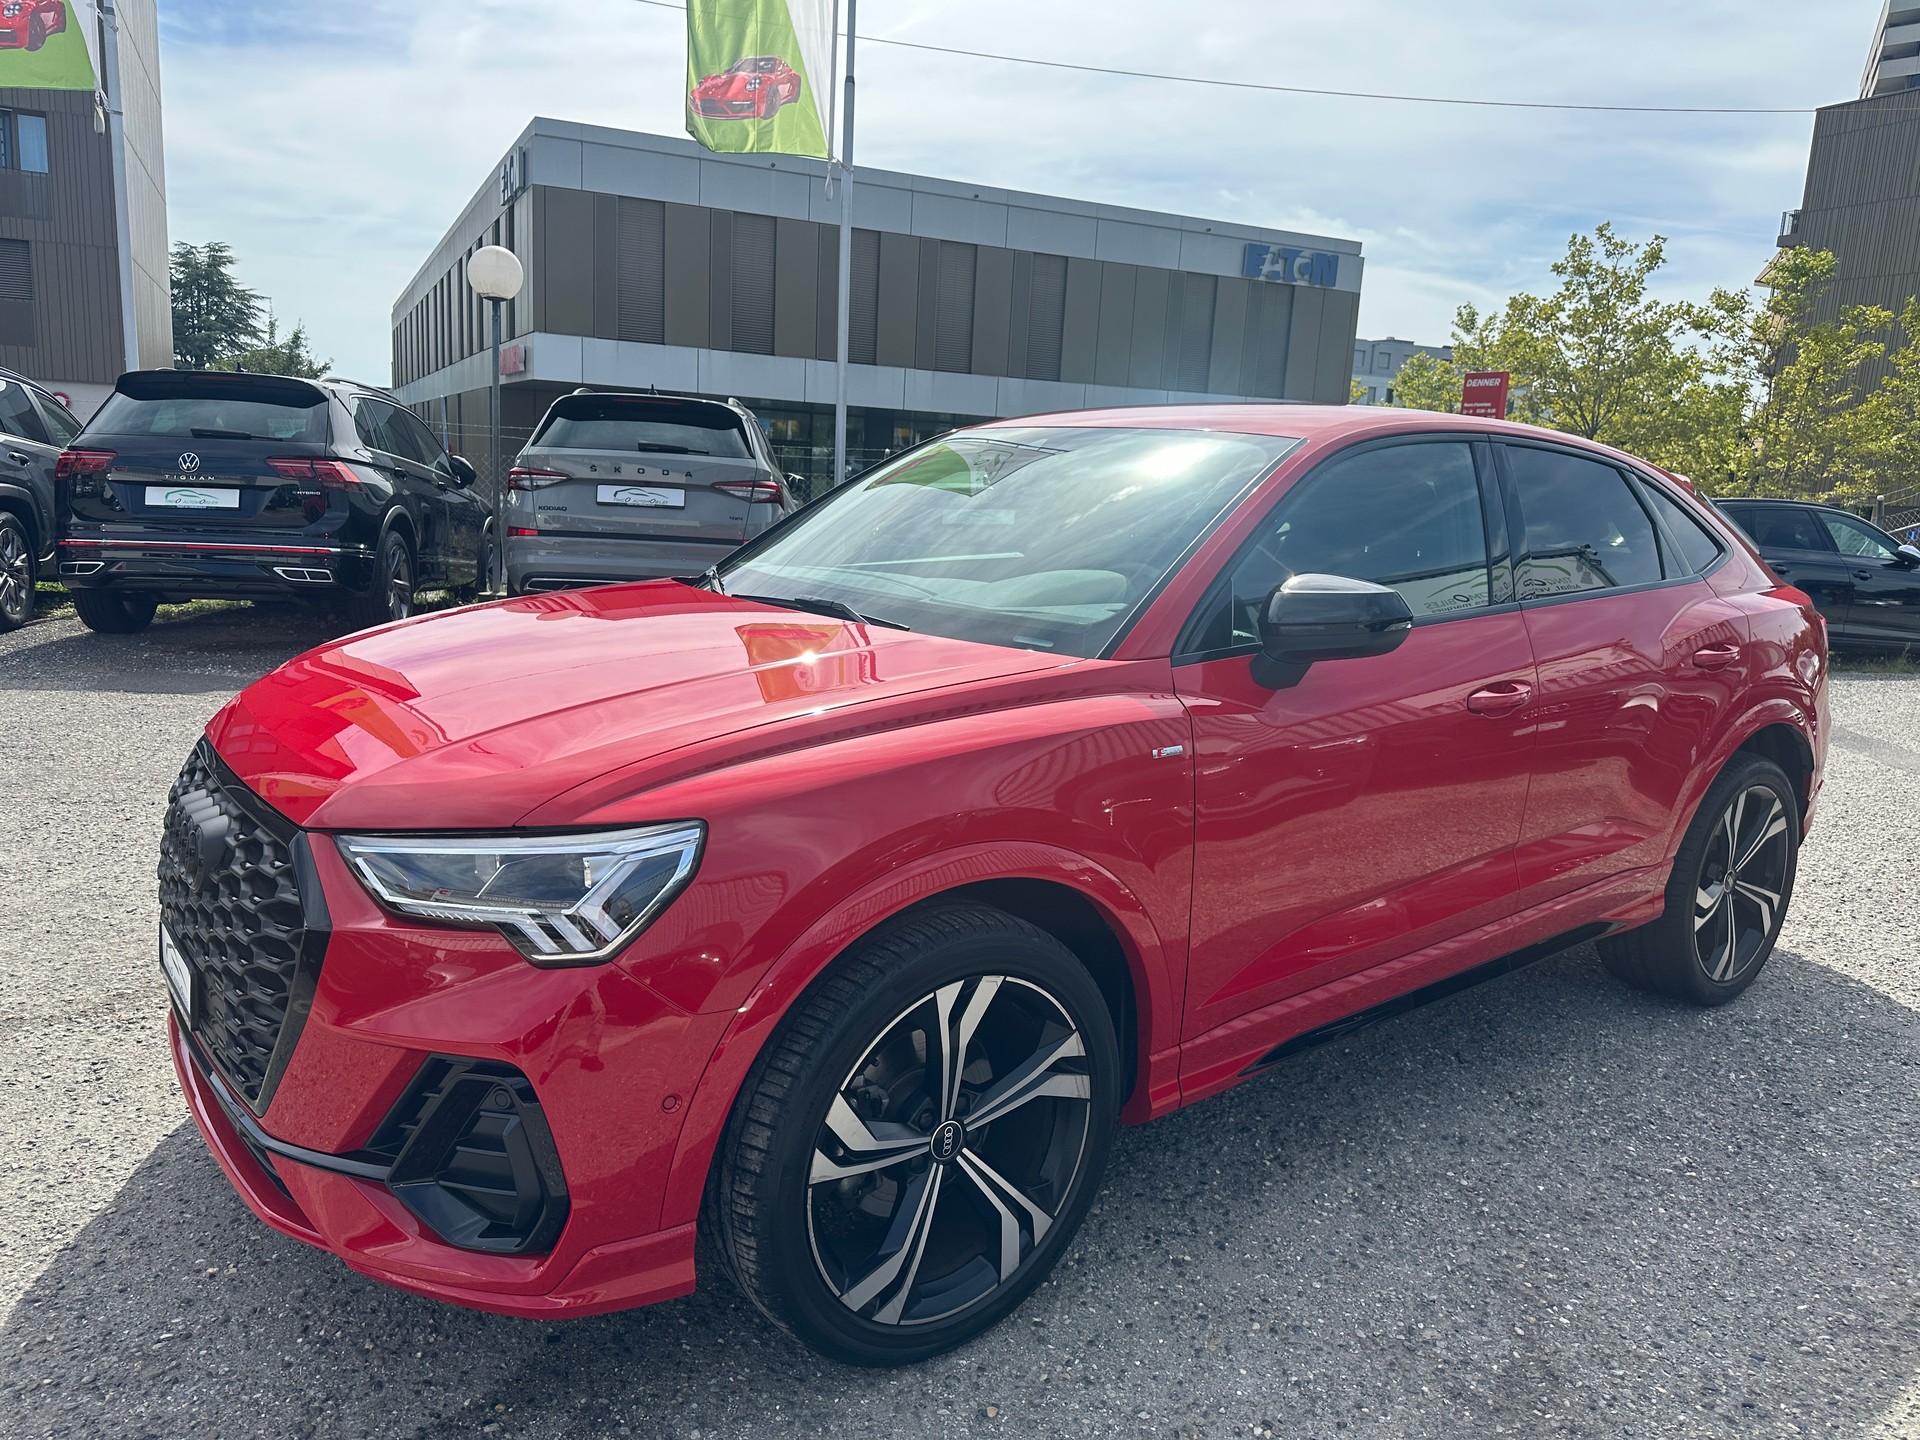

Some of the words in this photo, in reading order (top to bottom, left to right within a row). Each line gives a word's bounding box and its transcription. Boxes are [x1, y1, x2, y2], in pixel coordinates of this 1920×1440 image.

[1243, 243, 1339, 287] EATON
[1466, 378, 1501, 387] DENNER
[589, 464, 693, 478] ŠKODA
